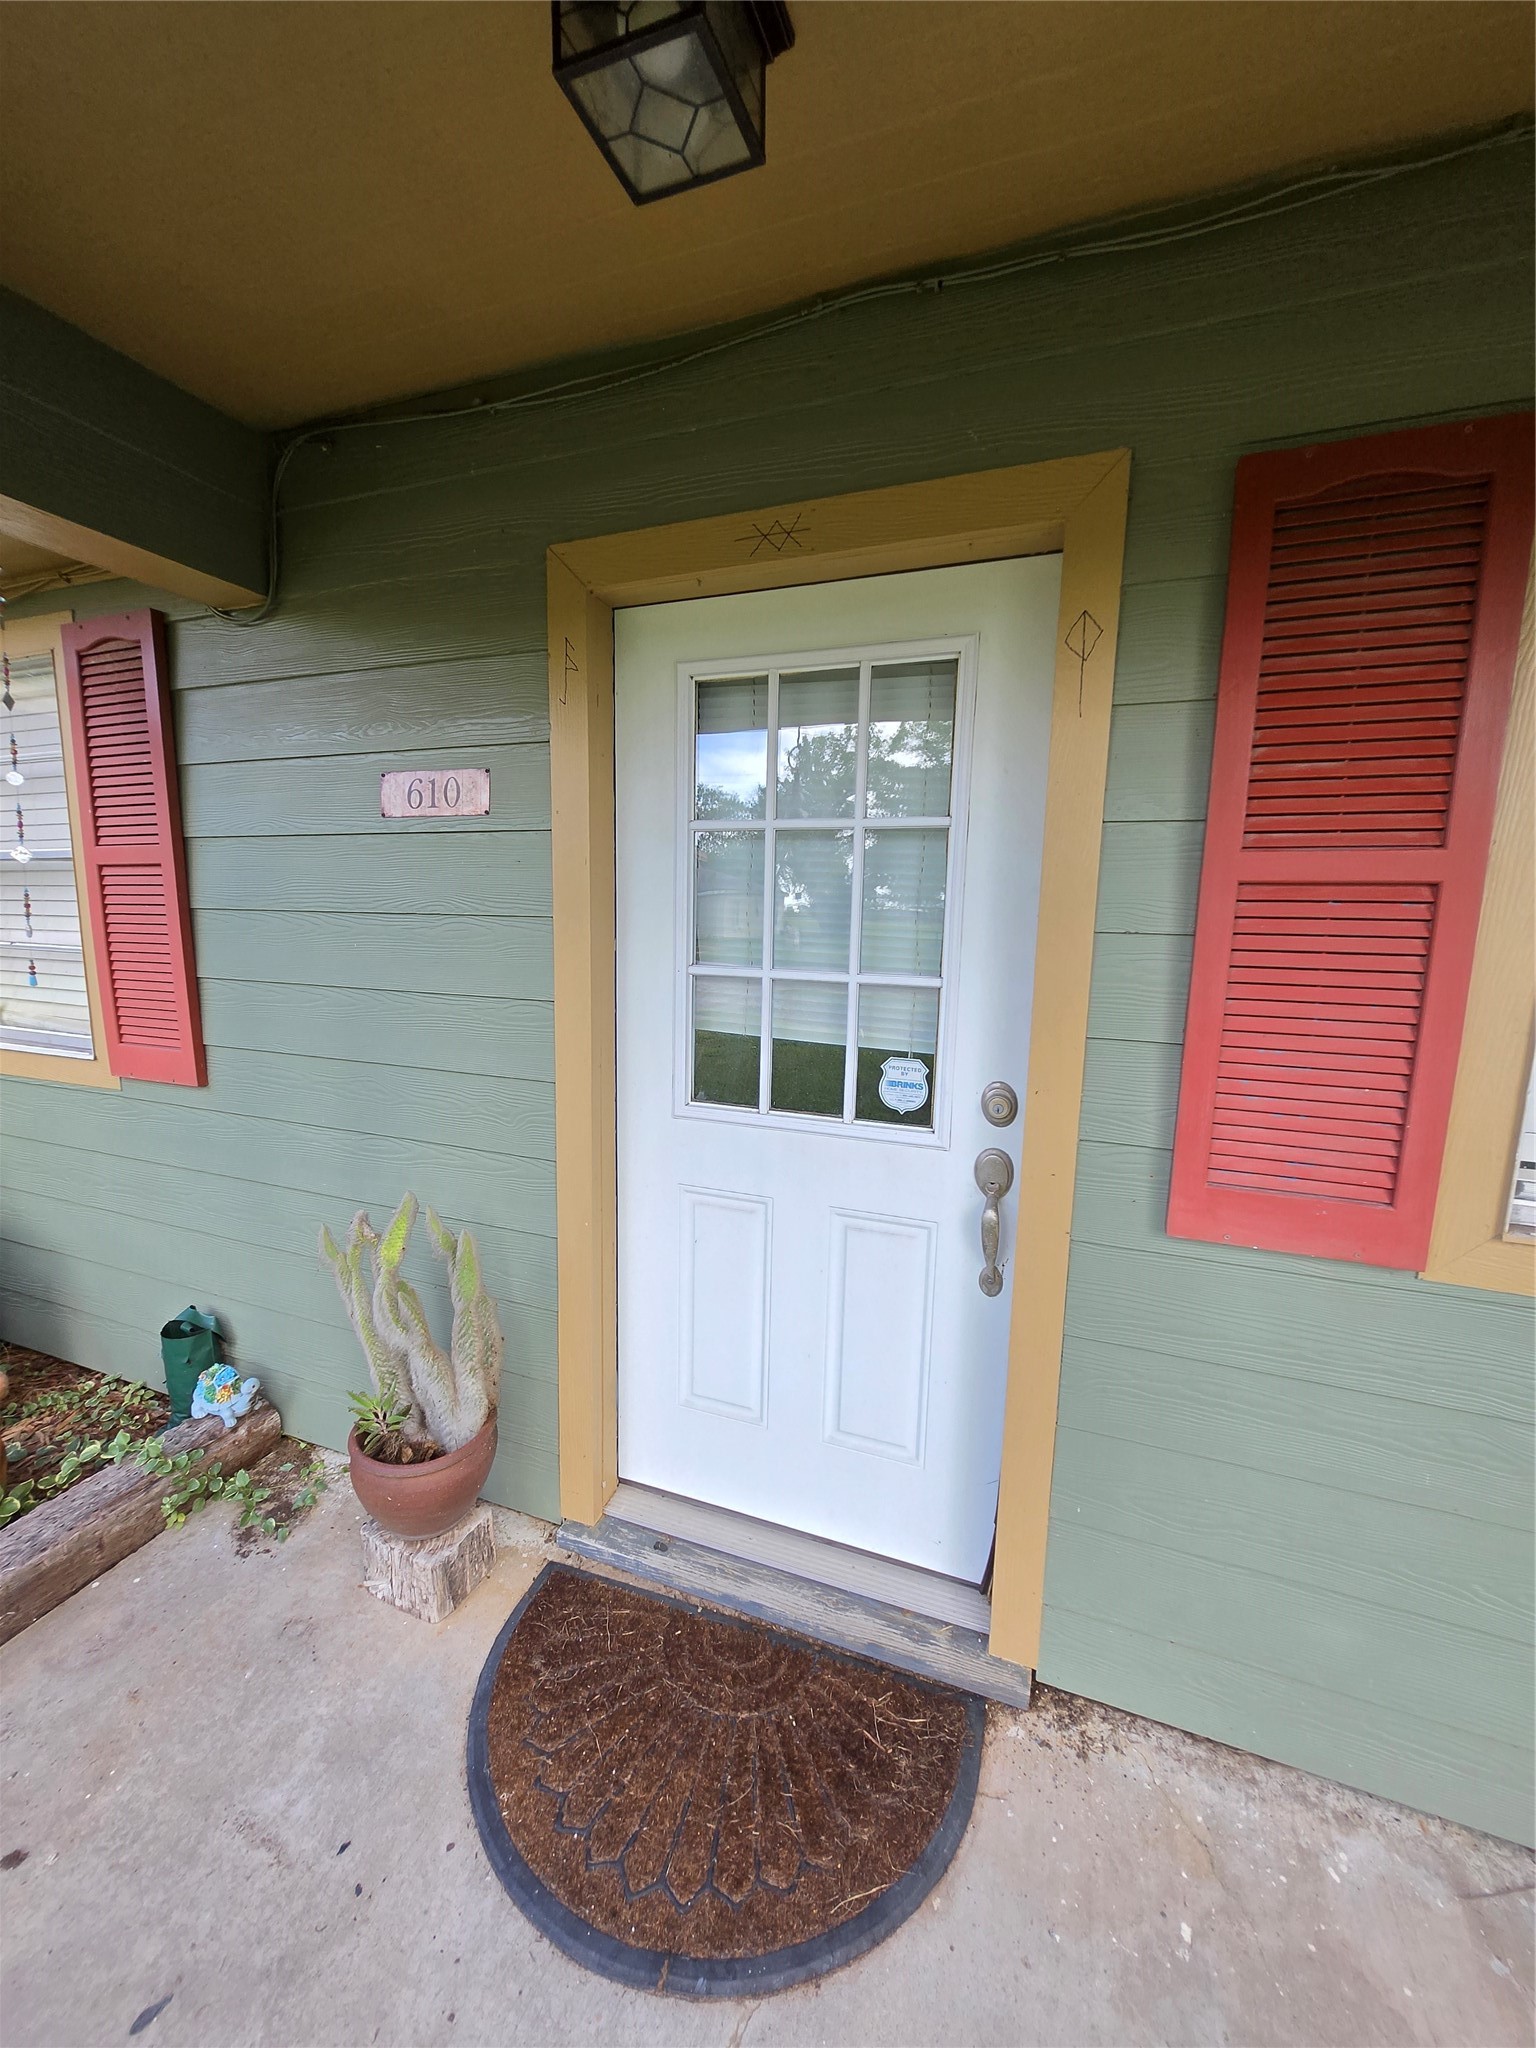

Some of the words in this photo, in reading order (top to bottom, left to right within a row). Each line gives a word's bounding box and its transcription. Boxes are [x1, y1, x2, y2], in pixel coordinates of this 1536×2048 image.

[407, 776, 461, 809] 610
[889, 1065, 922, 1073] PROTECTED
[887, 1080, 924, 1090] BRINKS
